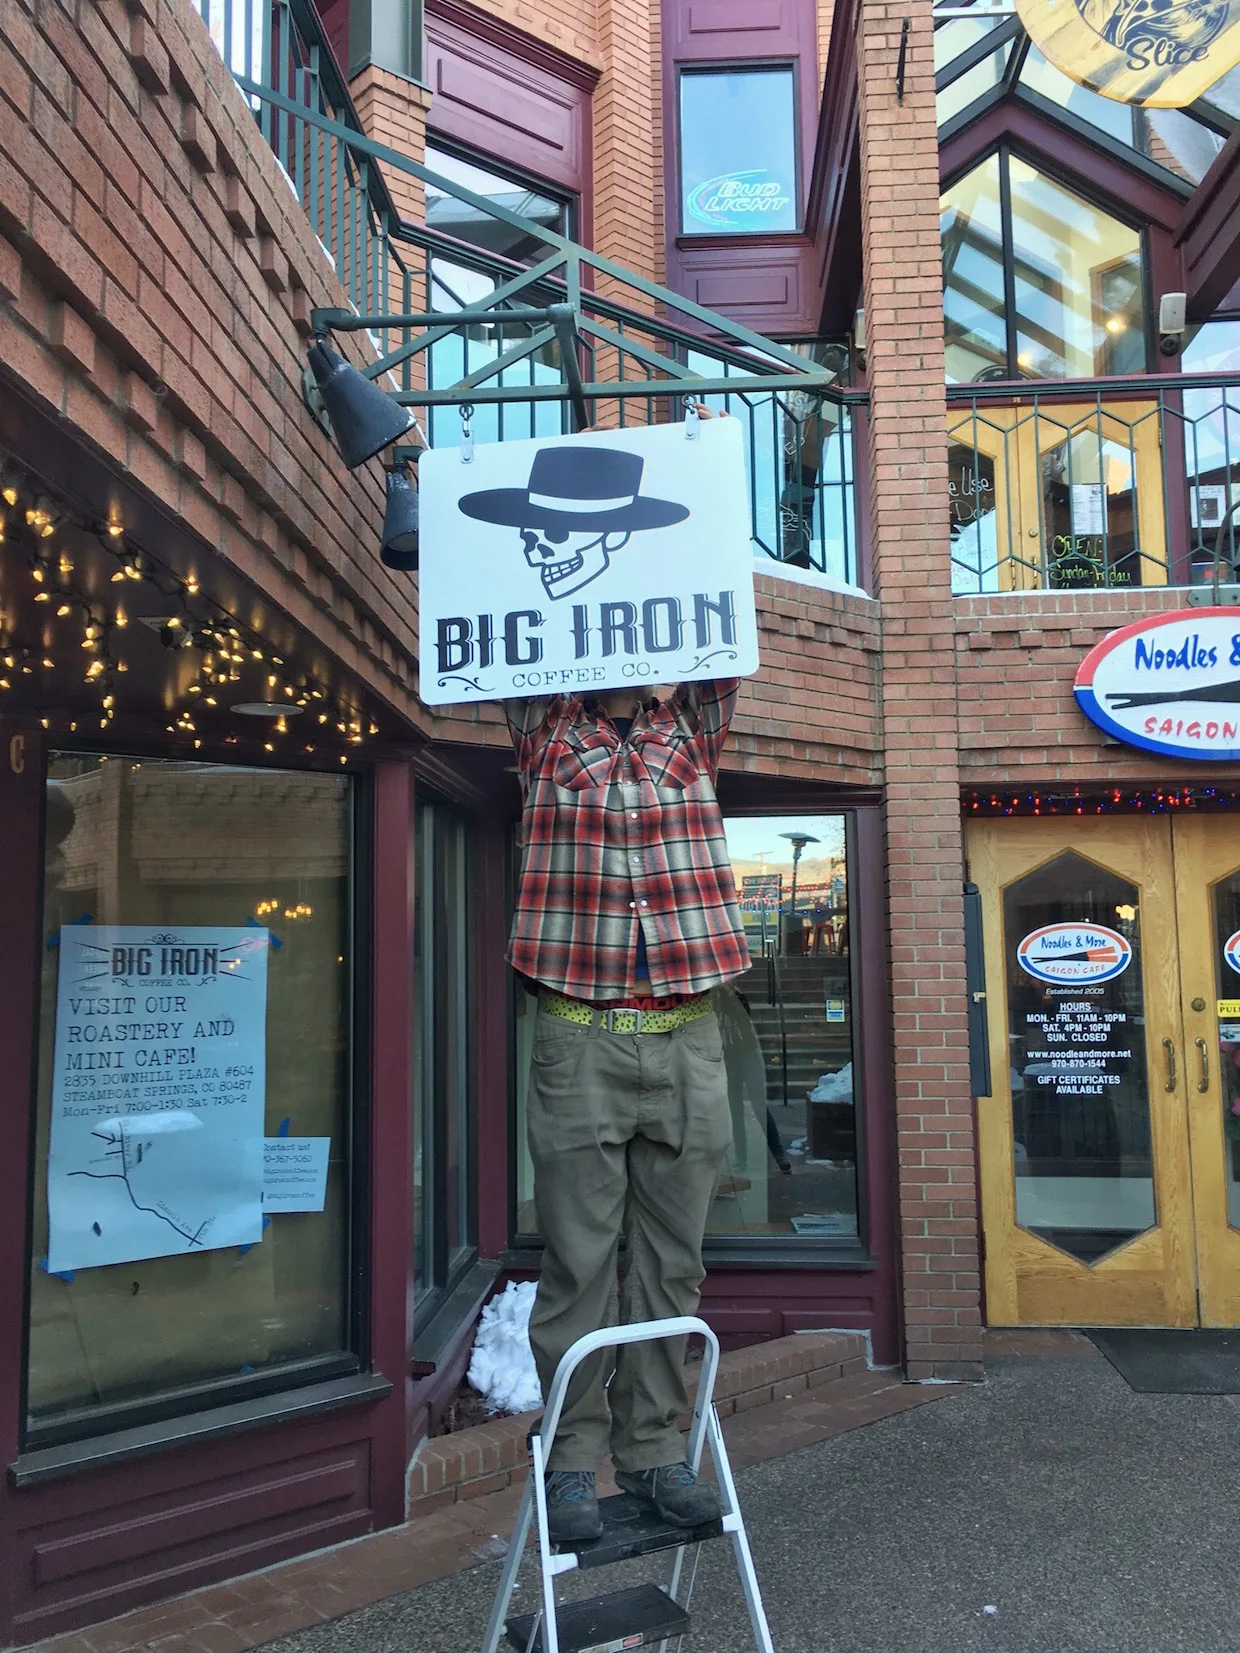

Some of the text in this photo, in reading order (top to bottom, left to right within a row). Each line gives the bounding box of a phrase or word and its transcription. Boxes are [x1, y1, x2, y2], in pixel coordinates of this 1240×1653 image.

[1125, 36, 1210, 71] Slice
[433, 590, 740, 674] BIG IRON
[1134, 634, 1218, 671] Noodles
[512, 662, 660, 689] COFFEE CO.
[1143, 716, 1238, 740] SAIGON
[1041, 935, 1072, 949] Noodles
[1075, 935, 1083, 947] &
[111, 947, 219, 976] BIG IRON
[1045, 965, 1106, 975] SAIGON CAFE
[139, 979, 173, 987] COFFEE
[1045, 987, 1105, 995] Established 2005
[69, 996, 187, 1016] VISIT OUR
[1059, 1002, 1092, 1012] HOURS
[1026, 1014, 1050, 1023] MON.
[1056, 1014, 1072, 1023] FRI.
[1076, 1014, 1097, 1022] 11AM
[1104, 1013, 1126, 1022] 10PM
[1042, 1024, 1060, 1032] SAT.
[1064, 1024, 1082, 1032] 4PM
[1089, 1023, 1111, 1032] 10PM
[67, 1019, 235, 1043] ROASTERY AND
[1047, 1033, 1107, 1042] SUN. CLOSED
[65, 1047, 196, 1070] MINI CAFE!
[1051, 1059, 1106, 1068] 970-870-1544
[64, 1065, 254, 1087] 2835 DOWNHILL PLAZA #604
[1037, 1075, 1121, 1084] GIFT CERTIFICATES
[62, 1080, 252, 1103] STEAMBOAT SPRINGS, CO 80487
[1056, 1085, 1103, 1094] AVAILABLE
[62, 1103, 120, 1117] Mon-Fri
[187, 1097, 208, 1109] Sat
